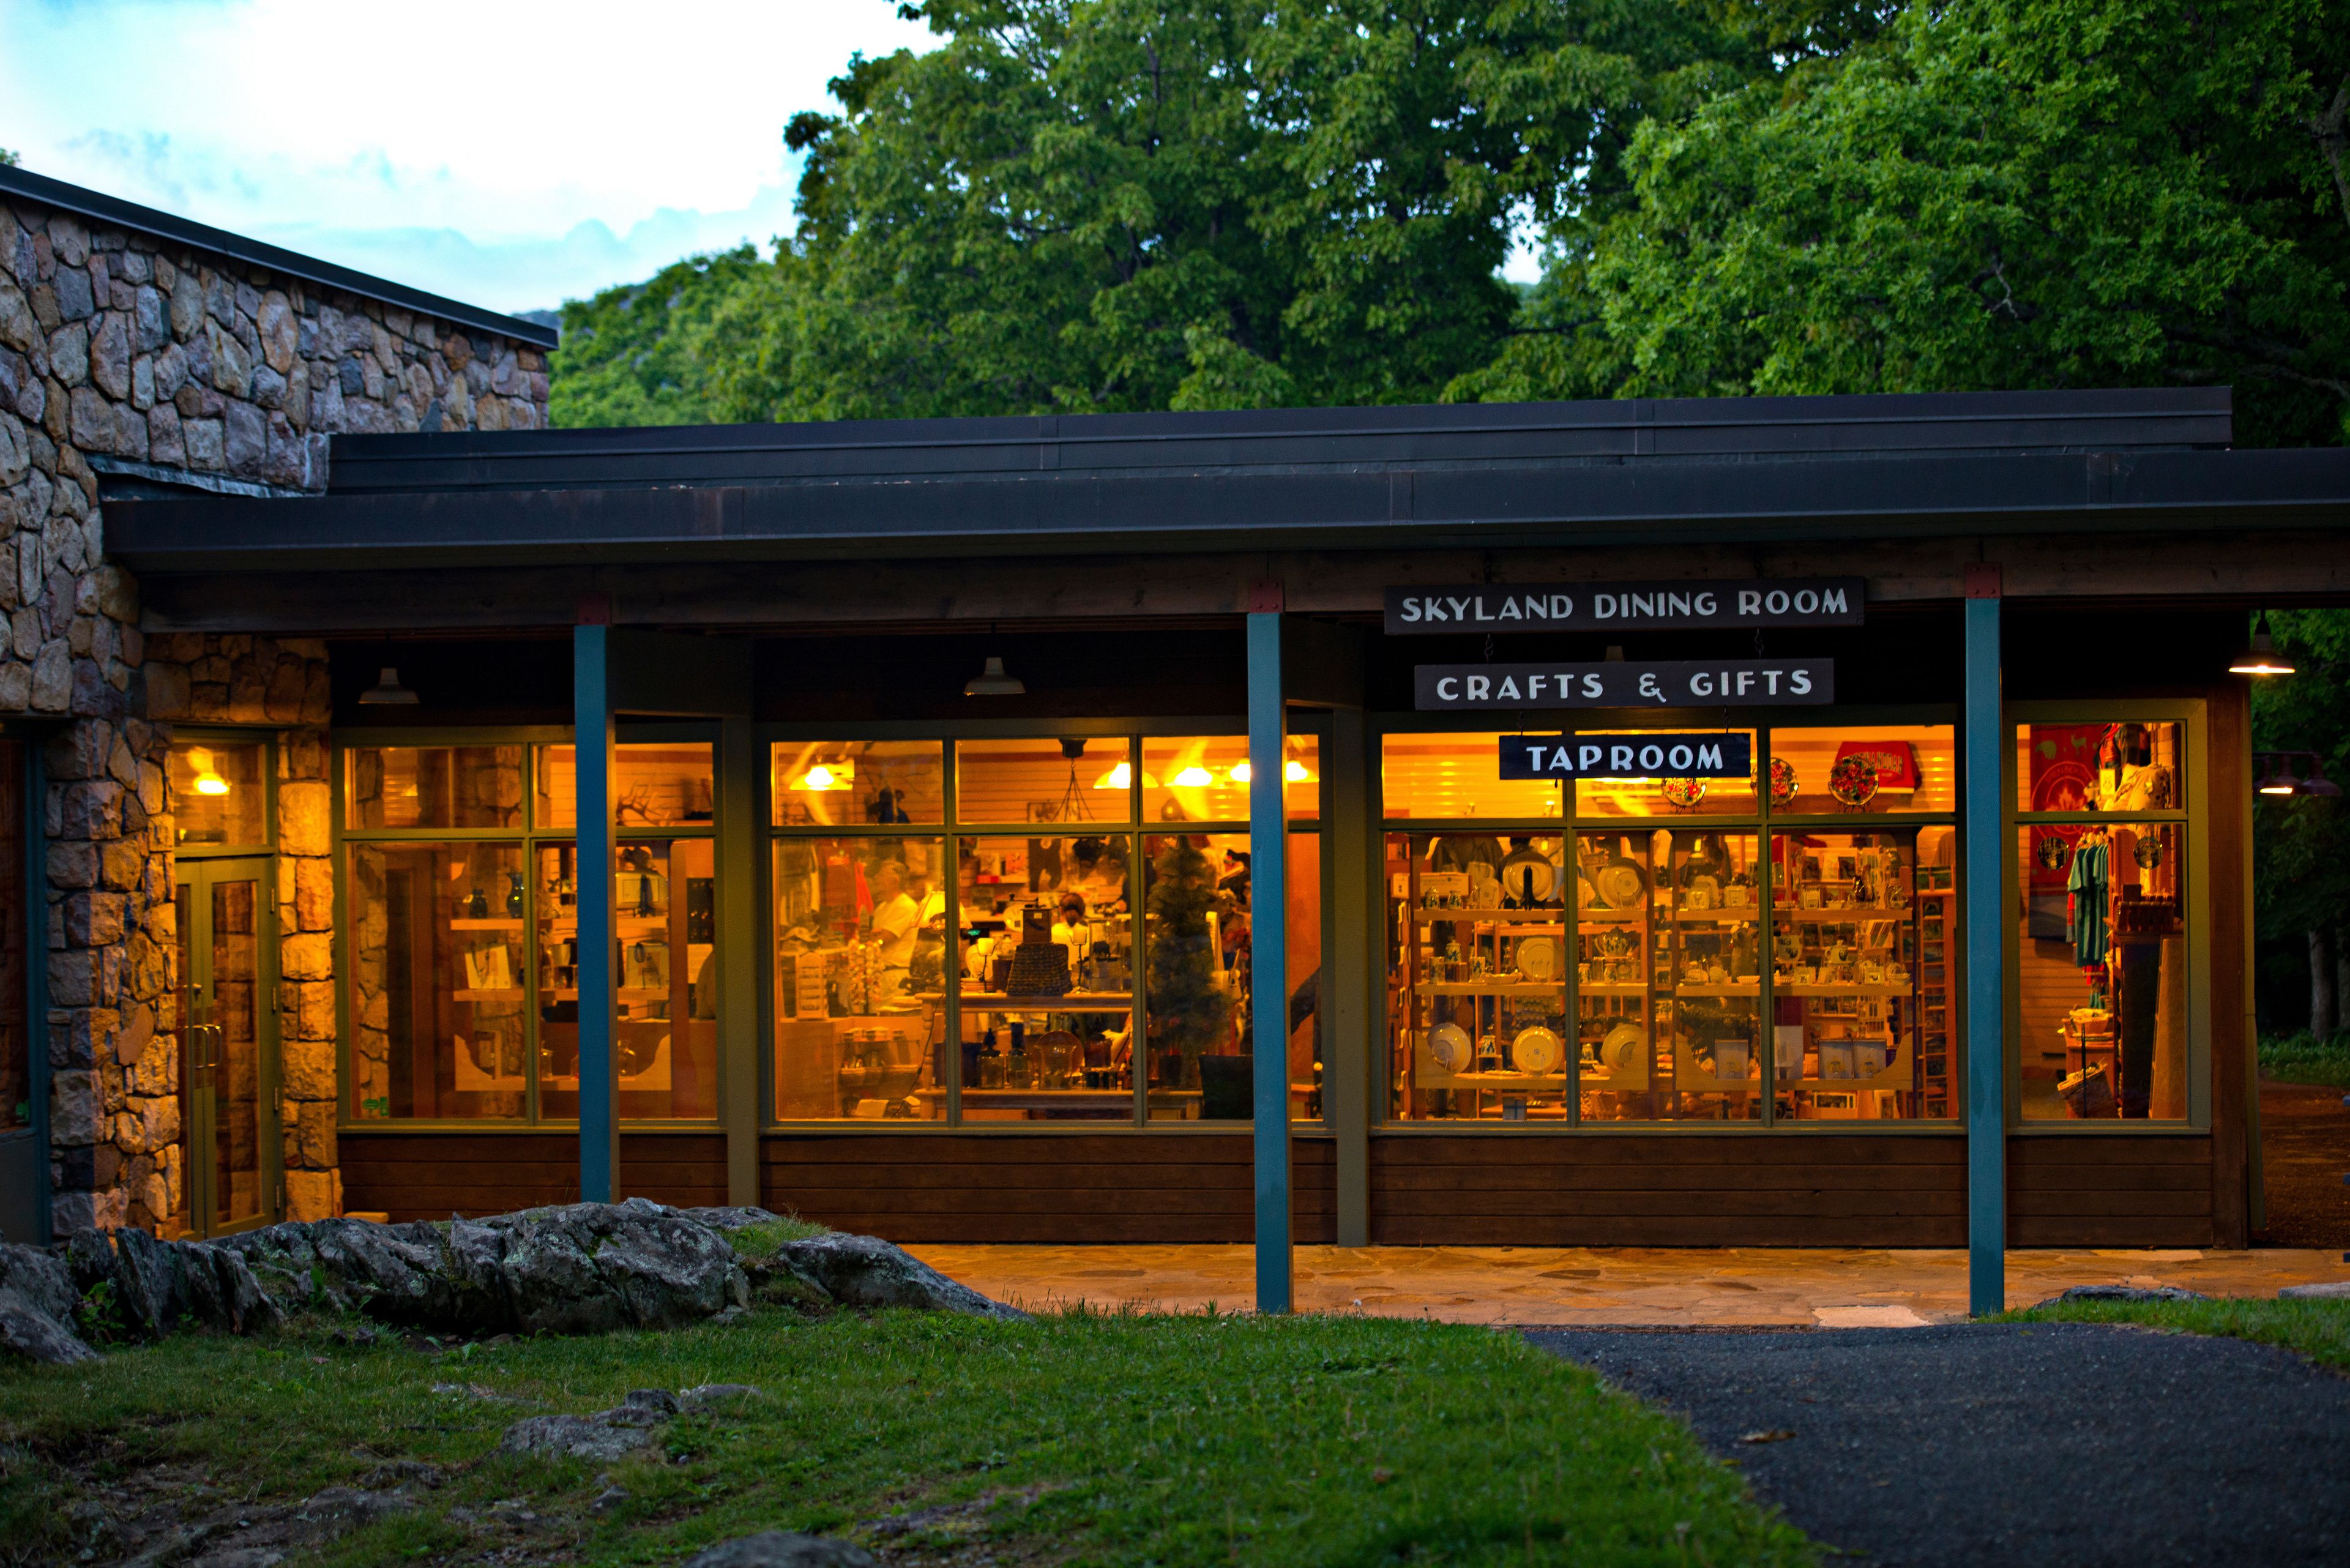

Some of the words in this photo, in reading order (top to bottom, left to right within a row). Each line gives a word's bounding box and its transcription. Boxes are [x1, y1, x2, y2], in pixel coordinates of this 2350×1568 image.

[1401, 595, 1573, 622] SKYLAND
[1595, 592, 1717, 619] DINING
[1739, 589, 1848, 615] ROOM
[1437, 673, 1603, 701] CRAFTS
[1639, 673, 1667, 703] &
[1690, 670, 1812, 696] GIFTS
[1526, 744, 1723, 771] TAPROOM
